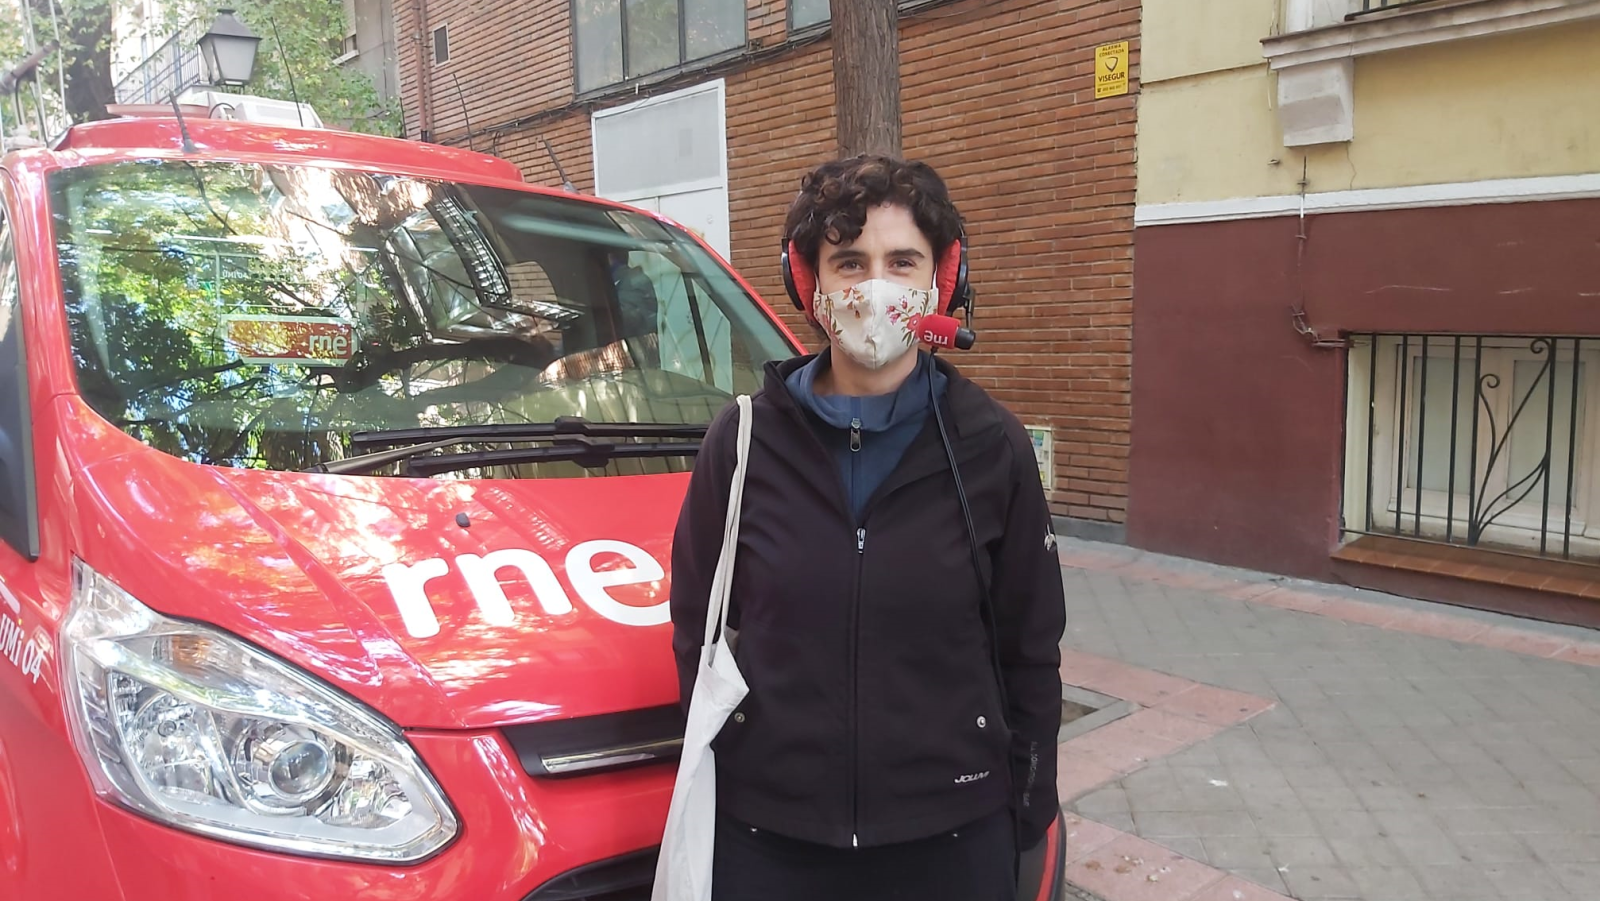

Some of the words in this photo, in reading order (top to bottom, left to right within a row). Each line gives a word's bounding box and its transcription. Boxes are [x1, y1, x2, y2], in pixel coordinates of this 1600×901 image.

[1098, 72, 1125, 82] VISEGUR
[309, 334, 347, 356] rne
[923, 330, 949, 346] rne
[381, 539, 671, 639] rne
[22, 639, 45, 685] 04
